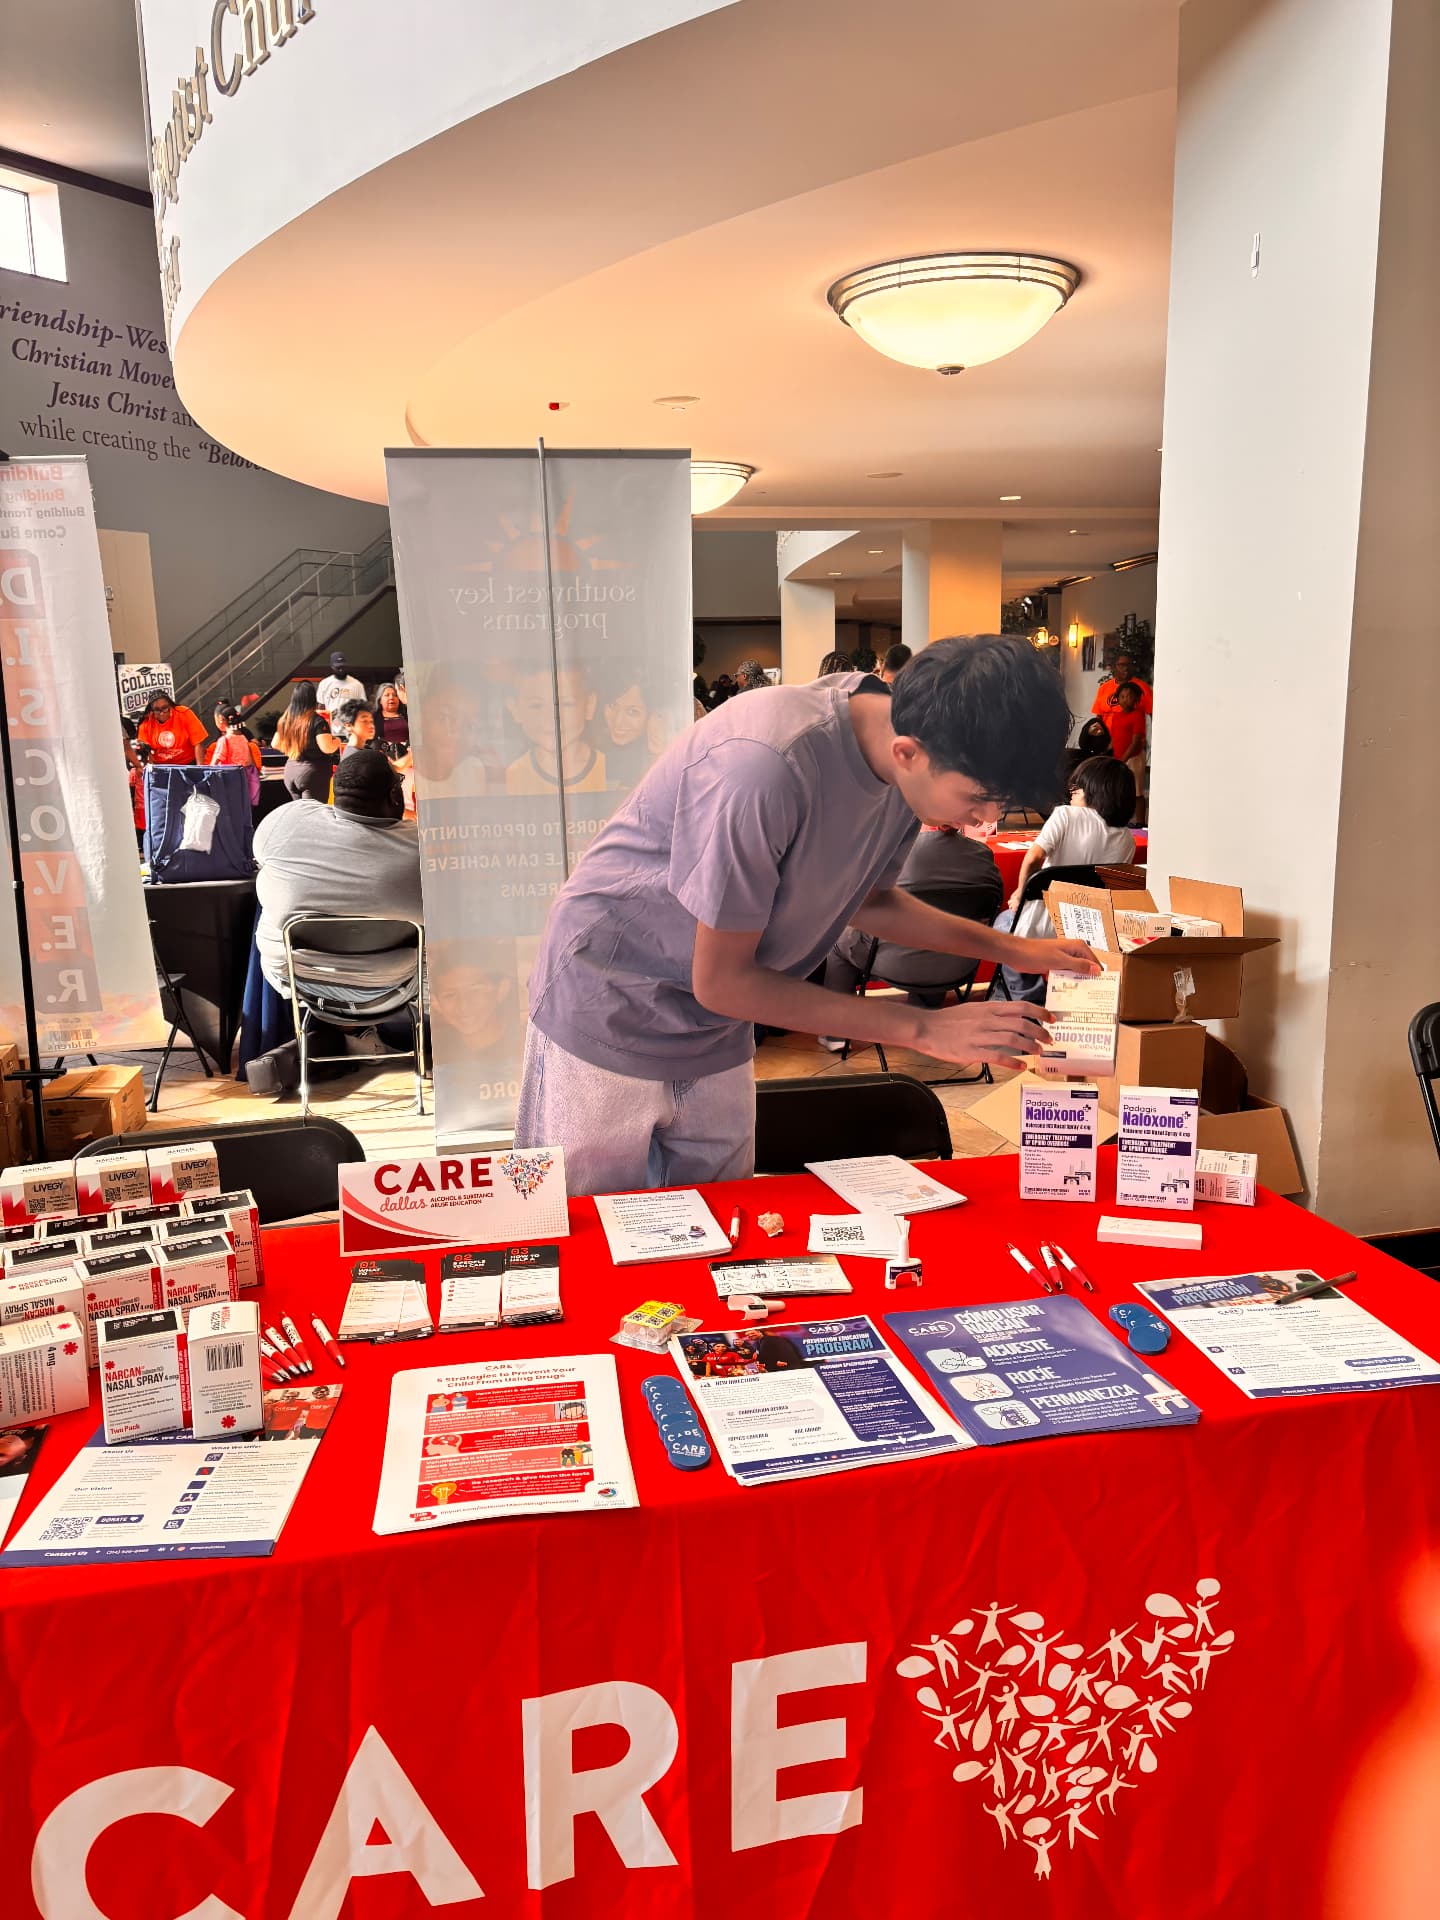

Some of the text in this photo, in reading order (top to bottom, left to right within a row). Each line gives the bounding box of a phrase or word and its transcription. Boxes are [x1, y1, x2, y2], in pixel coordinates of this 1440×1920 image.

[0, 303, 167, 354] riendship-Wes
[12, 338, 112, 376] Christian
[47, 381, 100, 410] Jesus
[108, 391, 167, 421] Christ
[19, 415, 76, 441] while
[83, 428, 158, 461] creating
[163, 436, 191, 459] the
[121, 673, 172, 694] COLLEGE
[1055, 1030, 1111, 1045] Naloxone
[1026, 1100, 1058, 1108] Padagis
[1124, 1105, 1157, 1113] Padagis
[1026, 1107, 1085, 1121] Naloxone
[1123, 1112, 1183, 1128] Naloxone
[181, 1160, 208, 1170] LIVEGY
[108, 1171, 137, 1181] LIVEGY
[374, 1157, 493, 1195] CARE
[34, 1182, 63, 1192] LIVEGY
[380, 1196, 428, 1212] dallas
[167, 1284, 198, 1298] NARCAN
[168, 1295, 192, 1307] NASAL
[194, 1289, 217, 1300] SPRAY
[1172, 1283, 1252, 1305] PREVENTION
[5, 1297, 54, 1314] NASAL SPRAY
[24, 1306, 54, 1320] NARCAN
[88, 1298, 120, 1312] NARCAN
[88, 1310, 114, 1321] NASAL
[116, 1303, 140, 1316] SPRAY
[954, 1304, 1047, 1325] CÓMO USAR
[808, 1325, 838, 1334] CARE
[908, 1324, 947, 1334] CARE
[962, 1317, 1031, 1335] NARCAN
[806, 1339, 873, 1355] PROGRAM
[981, 1338, 1055, 1358] ACUESTE
[105, 1366, 141, 1382] NARCAN
[445, 1373, 498, 1384] Strategies
[512, 1369, 550, 1377] Prevent
[1005, 1365, 1061, 1385] ROCÍE
[106, 1380, 135, 1392] NASAL
[137, 1373, 164, 1387] SPRAY
[1030, 1384, 1140, 1410] PERMANEZCA
[673, 1443, 706, 1453] CARE
[30, 1640, 868, 1920] CARE
